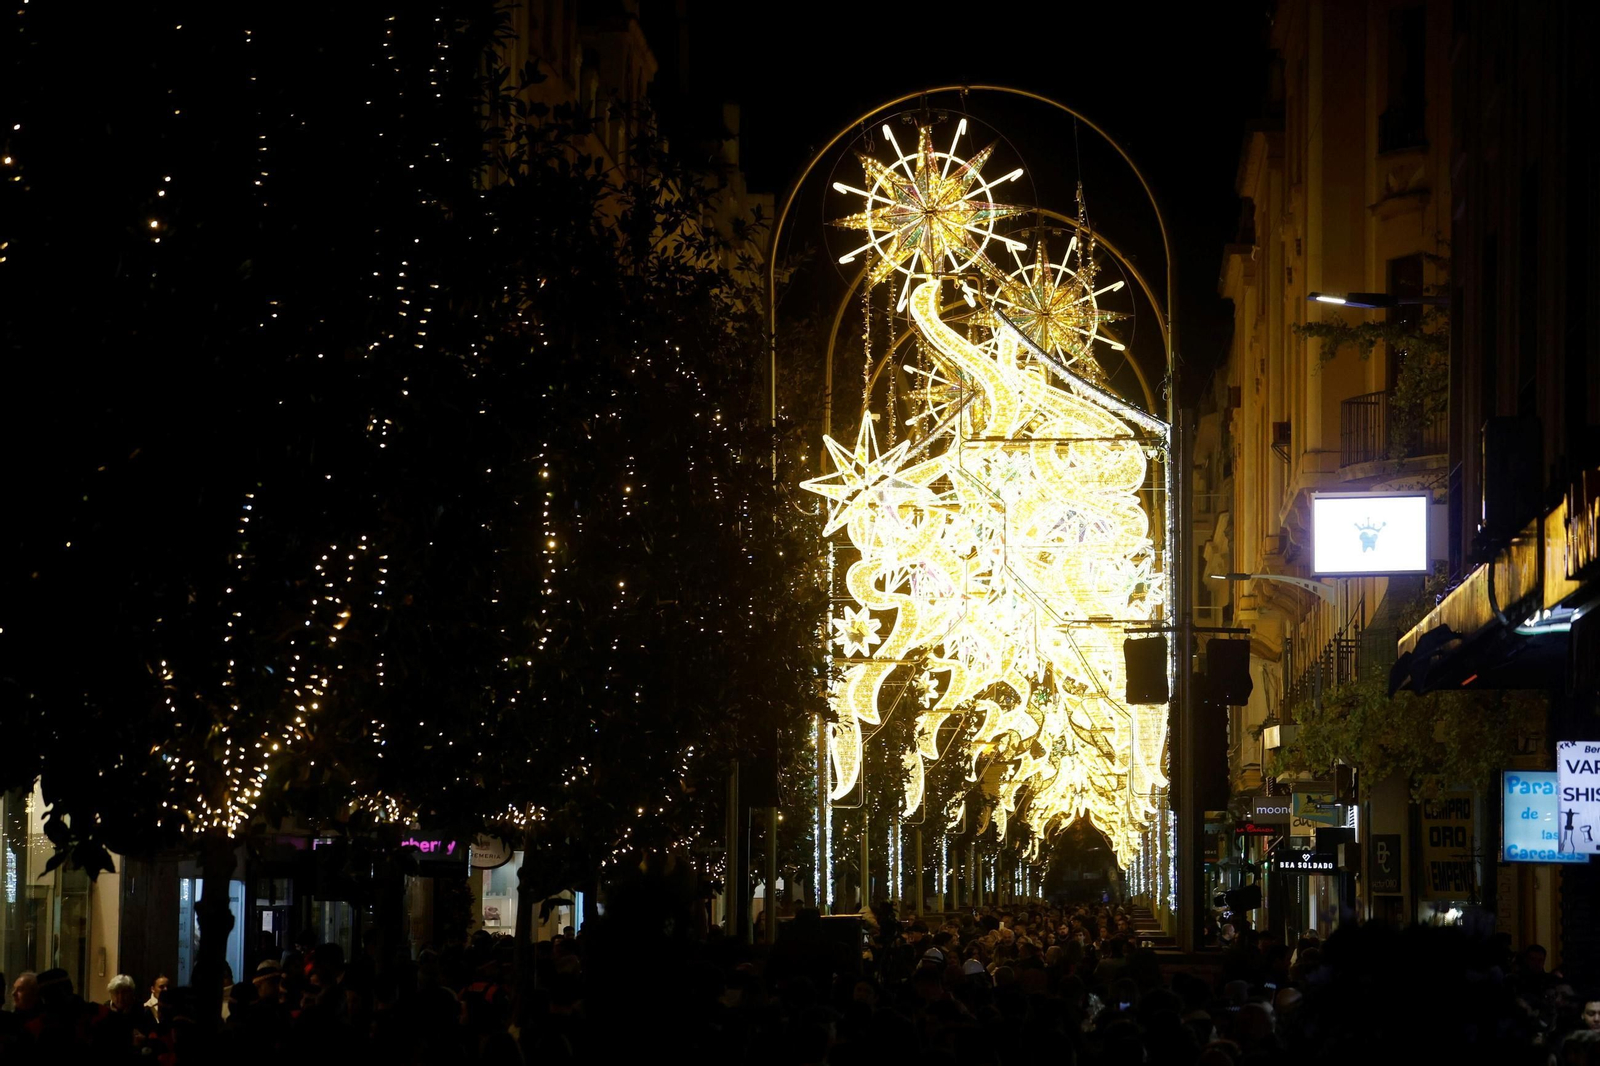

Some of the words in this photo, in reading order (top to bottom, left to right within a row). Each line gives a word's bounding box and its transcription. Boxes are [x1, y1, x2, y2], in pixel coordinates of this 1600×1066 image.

[1507, 776, 1557, 795] Para
[1521, 807, 1538, 819] de
[1297, 862, 1334, 870] SOLDADO
